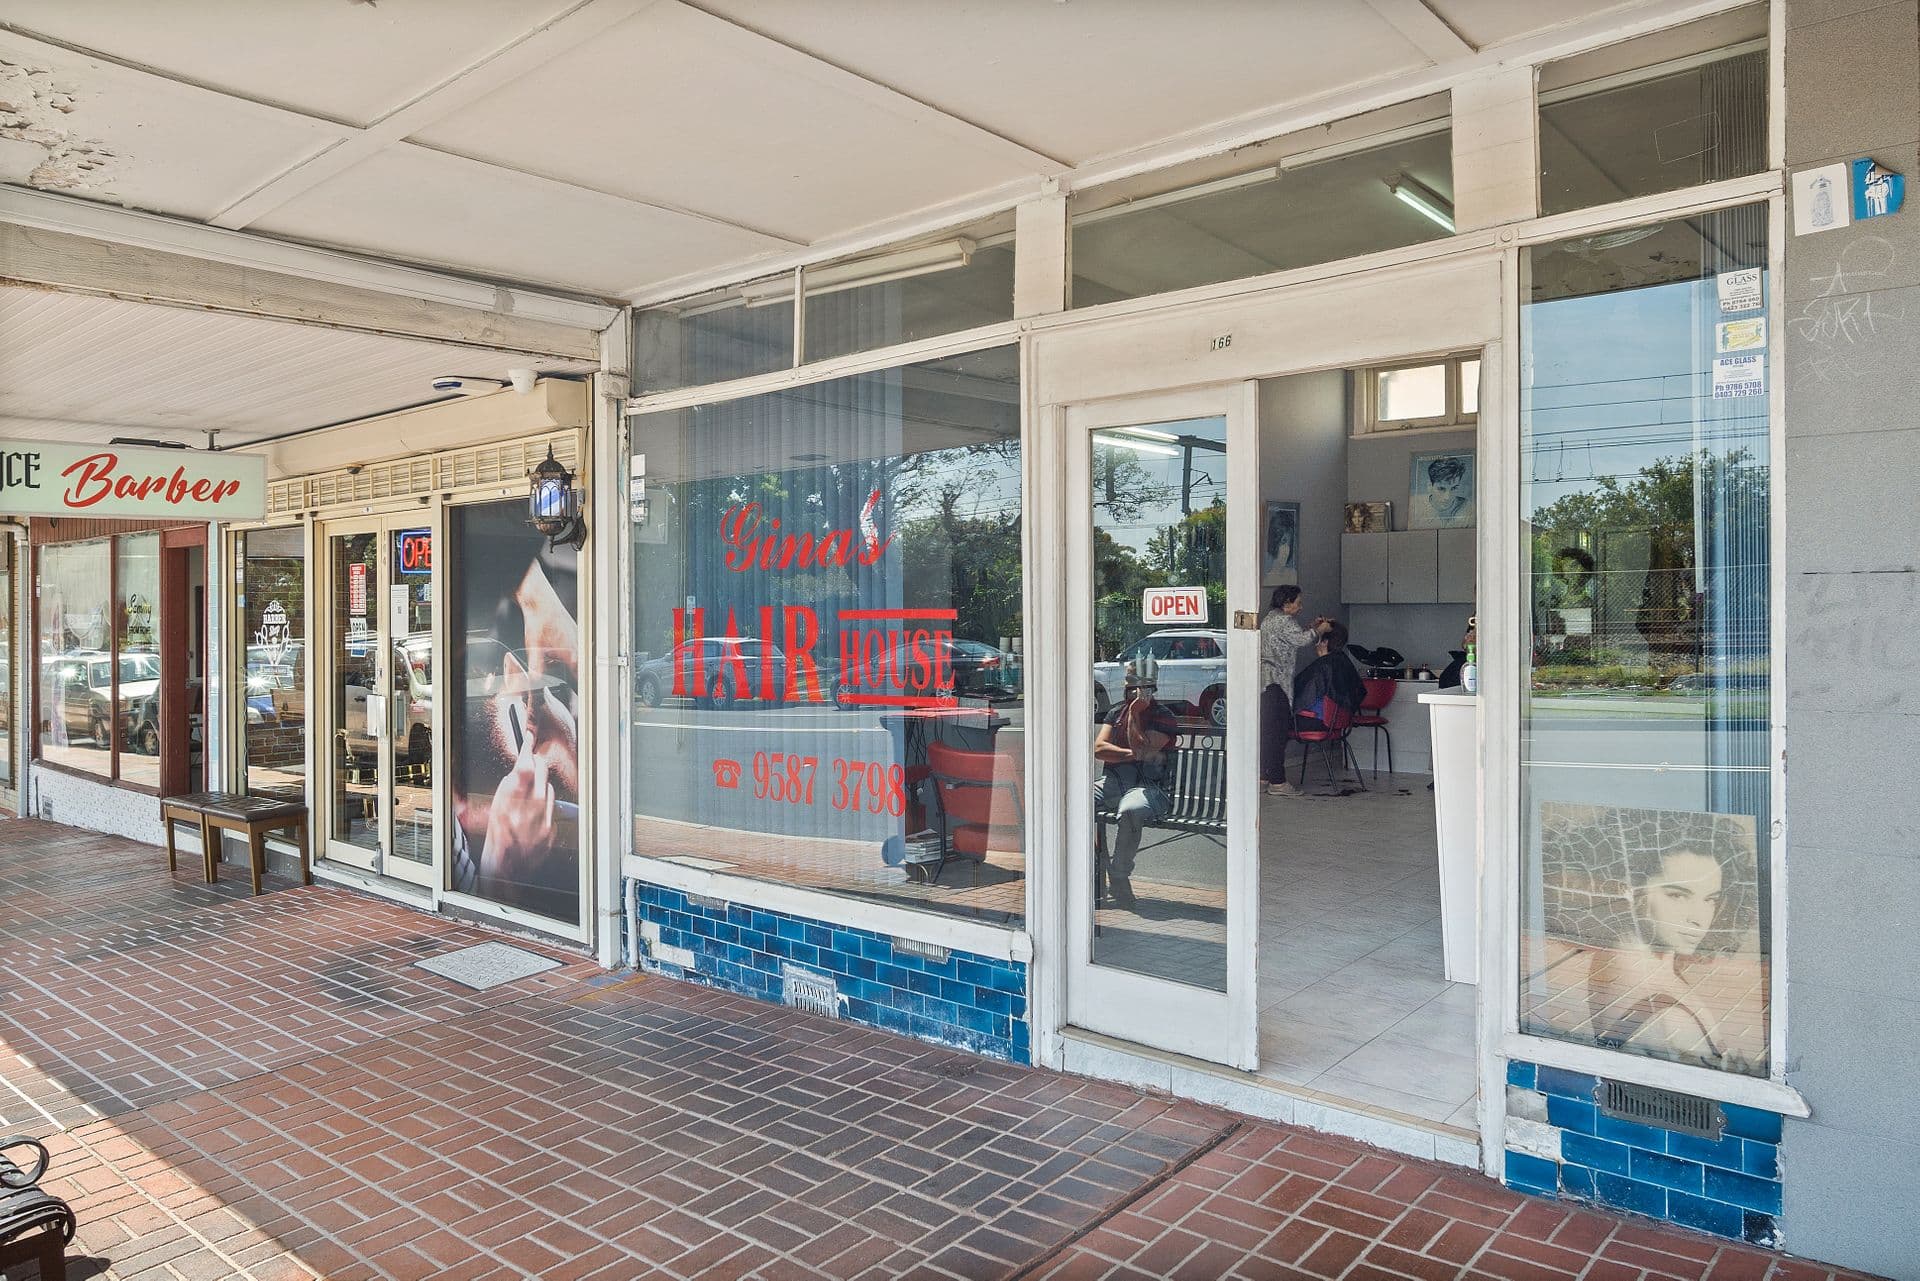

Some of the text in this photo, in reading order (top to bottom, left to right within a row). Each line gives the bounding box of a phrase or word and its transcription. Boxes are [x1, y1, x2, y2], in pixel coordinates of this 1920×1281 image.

[1726, 273, 1757, 286] GLASS
[1212, 335, 1232, 350] 166
[1734, 356, 1757, 365] GLASS
[0, 452, 240, 508] CE Barber
[403, 537, 432, 568] OPE
[1151, 595, 1198, 616] OPEN
[672, 604, 956, 702] HAIR HOUSE
[752, 752, 906, 818] 9587 3798
